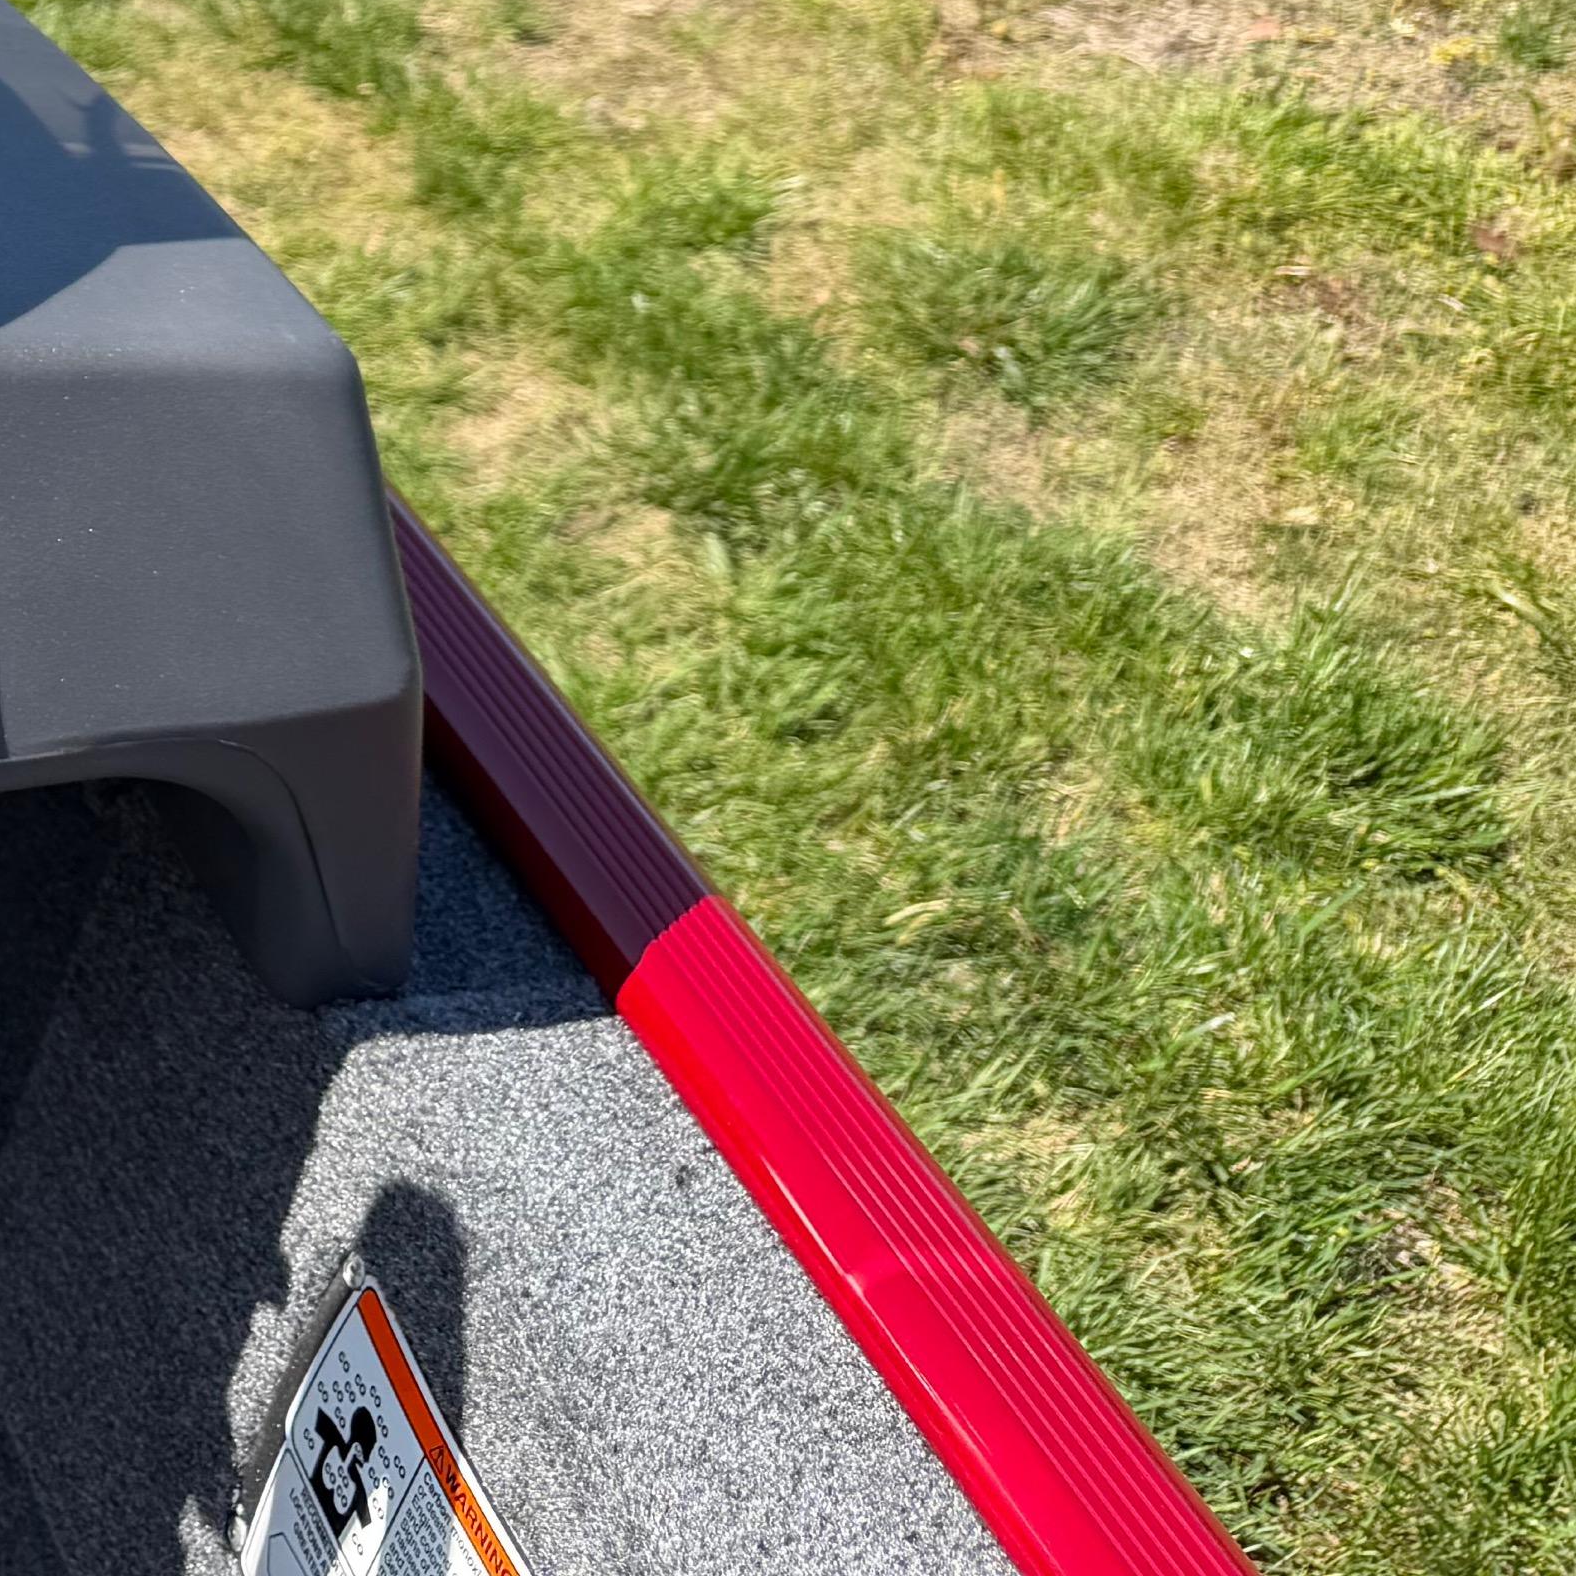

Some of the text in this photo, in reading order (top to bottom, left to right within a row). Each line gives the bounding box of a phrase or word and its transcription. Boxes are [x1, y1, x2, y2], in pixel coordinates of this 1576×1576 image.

[418, 1485, 427, 1499] or
[424, 1472, 452, 1525] Carbon
[406, 1507, 425, 1535] and
[411, 1493, 437, 1544] Engine
[389, 1542, 405, 1569] and
[400, 1517, 421, 1559] Signs
